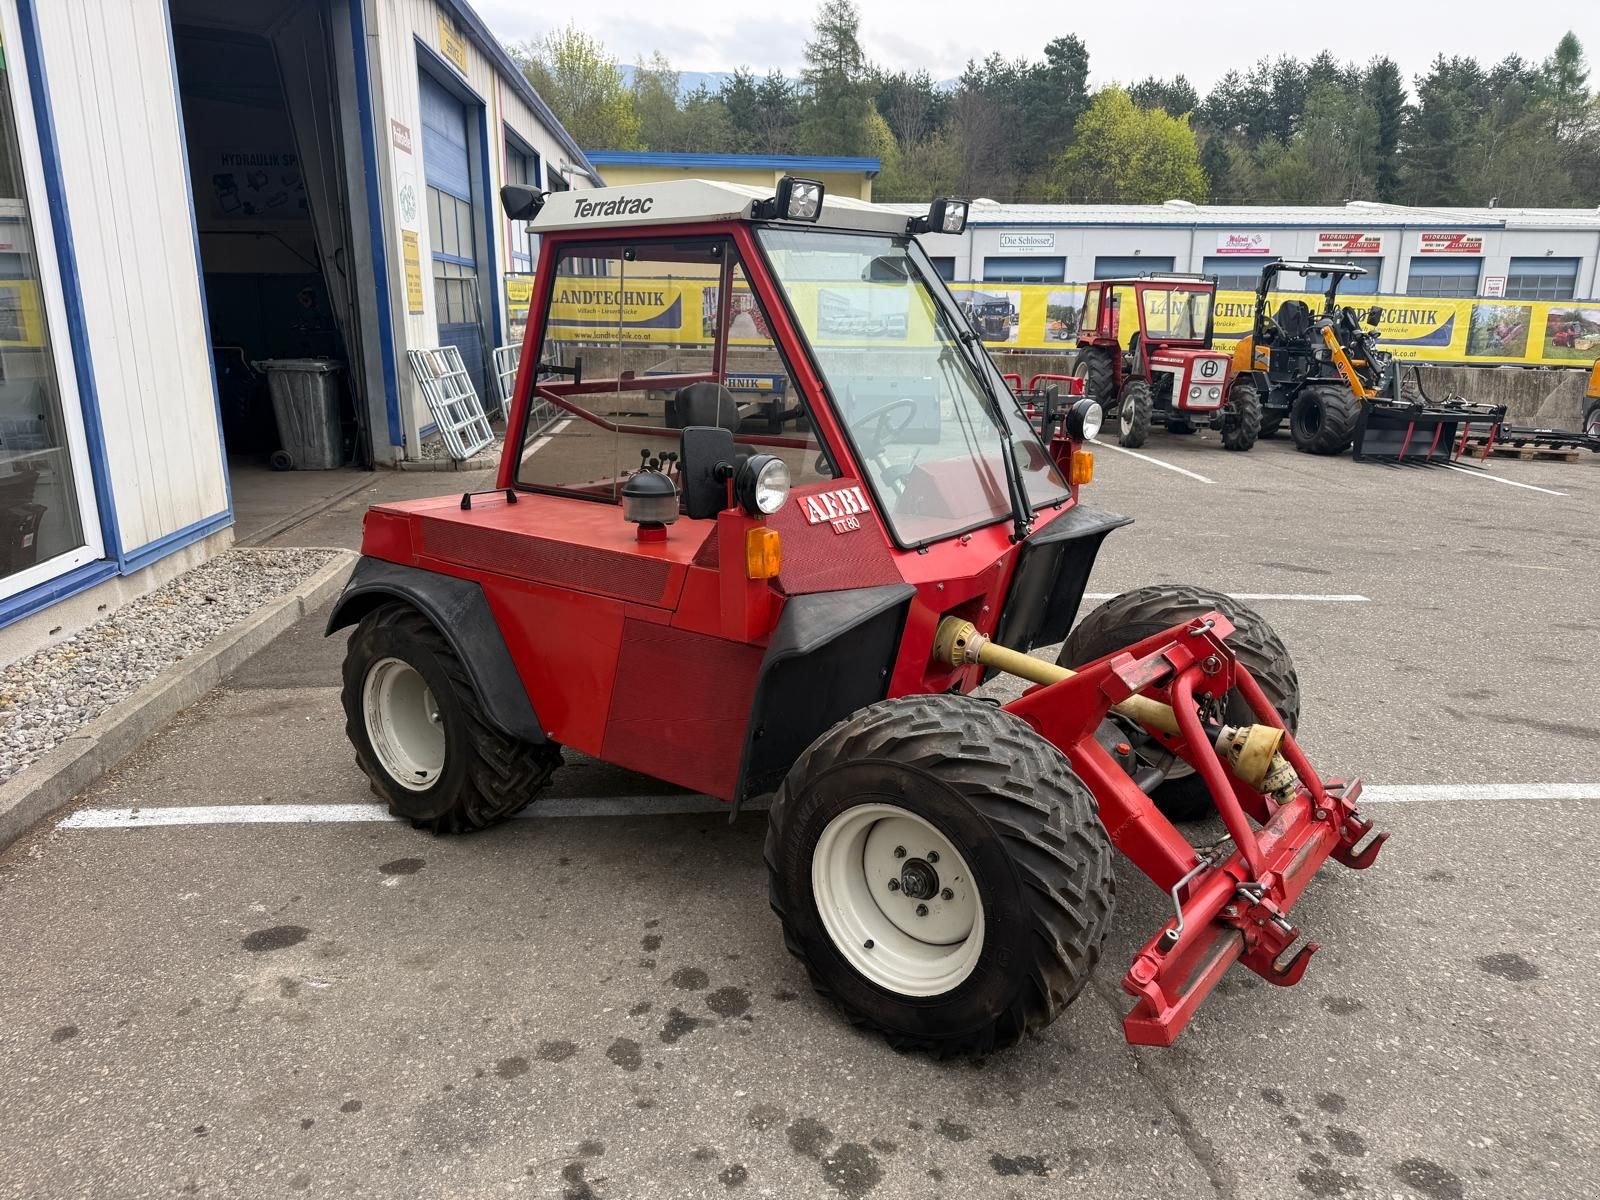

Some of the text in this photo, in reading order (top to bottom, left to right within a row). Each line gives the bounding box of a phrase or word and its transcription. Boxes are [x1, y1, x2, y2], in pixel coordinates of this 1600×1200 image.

[221, 153, 281, 166] HYDRAULIK
[574, 196, 653, 218] Terratrac
[1004, 236, 1016, 245] Die
[807, 487, 870, 523] AEBI
[833, 517, 860, 534] TT80
